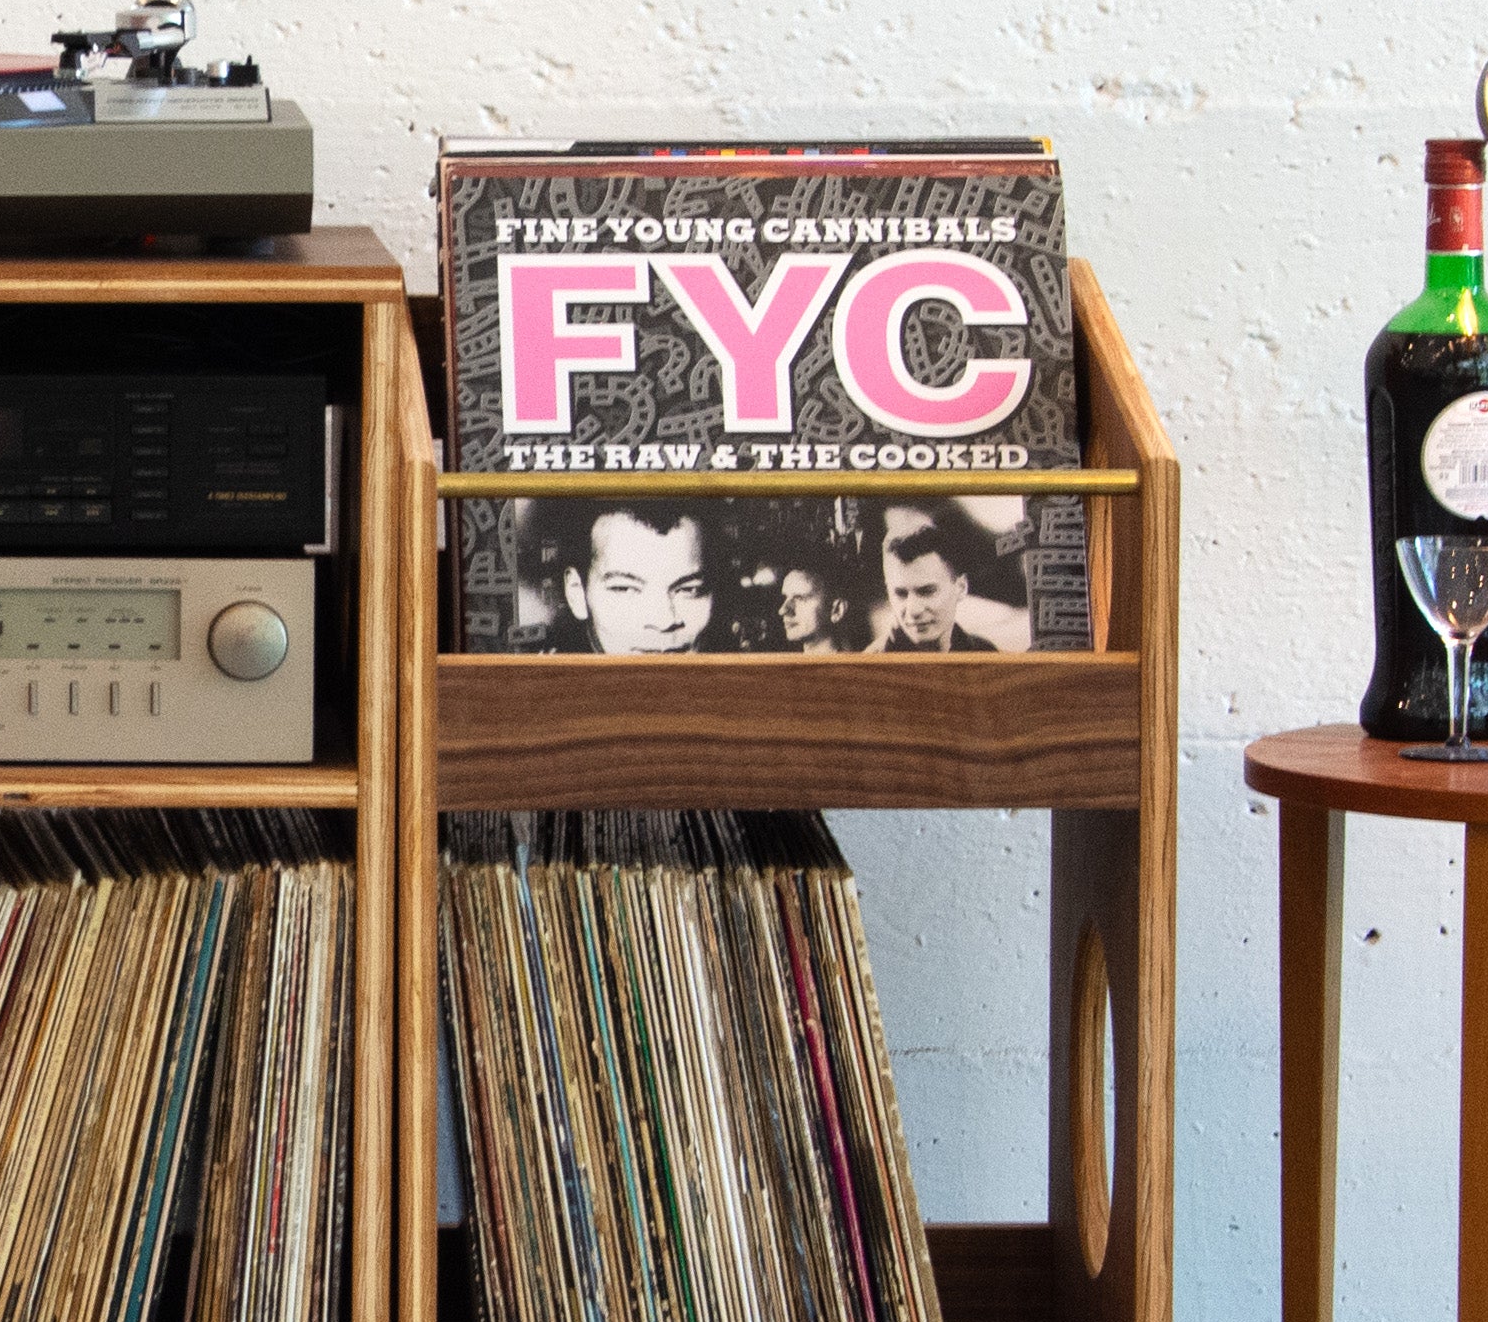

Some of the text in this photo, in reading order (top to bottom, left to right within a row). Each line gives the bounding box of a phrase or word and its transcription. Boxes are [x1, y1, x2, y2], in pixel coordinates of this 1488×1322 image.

[496, 217, 1017, 244] FINE YOUNG CANNIBALS
[497, 248, 1031, 437] FYC
[503, 444, 1029, 470] THE RAW & THE COOKED
